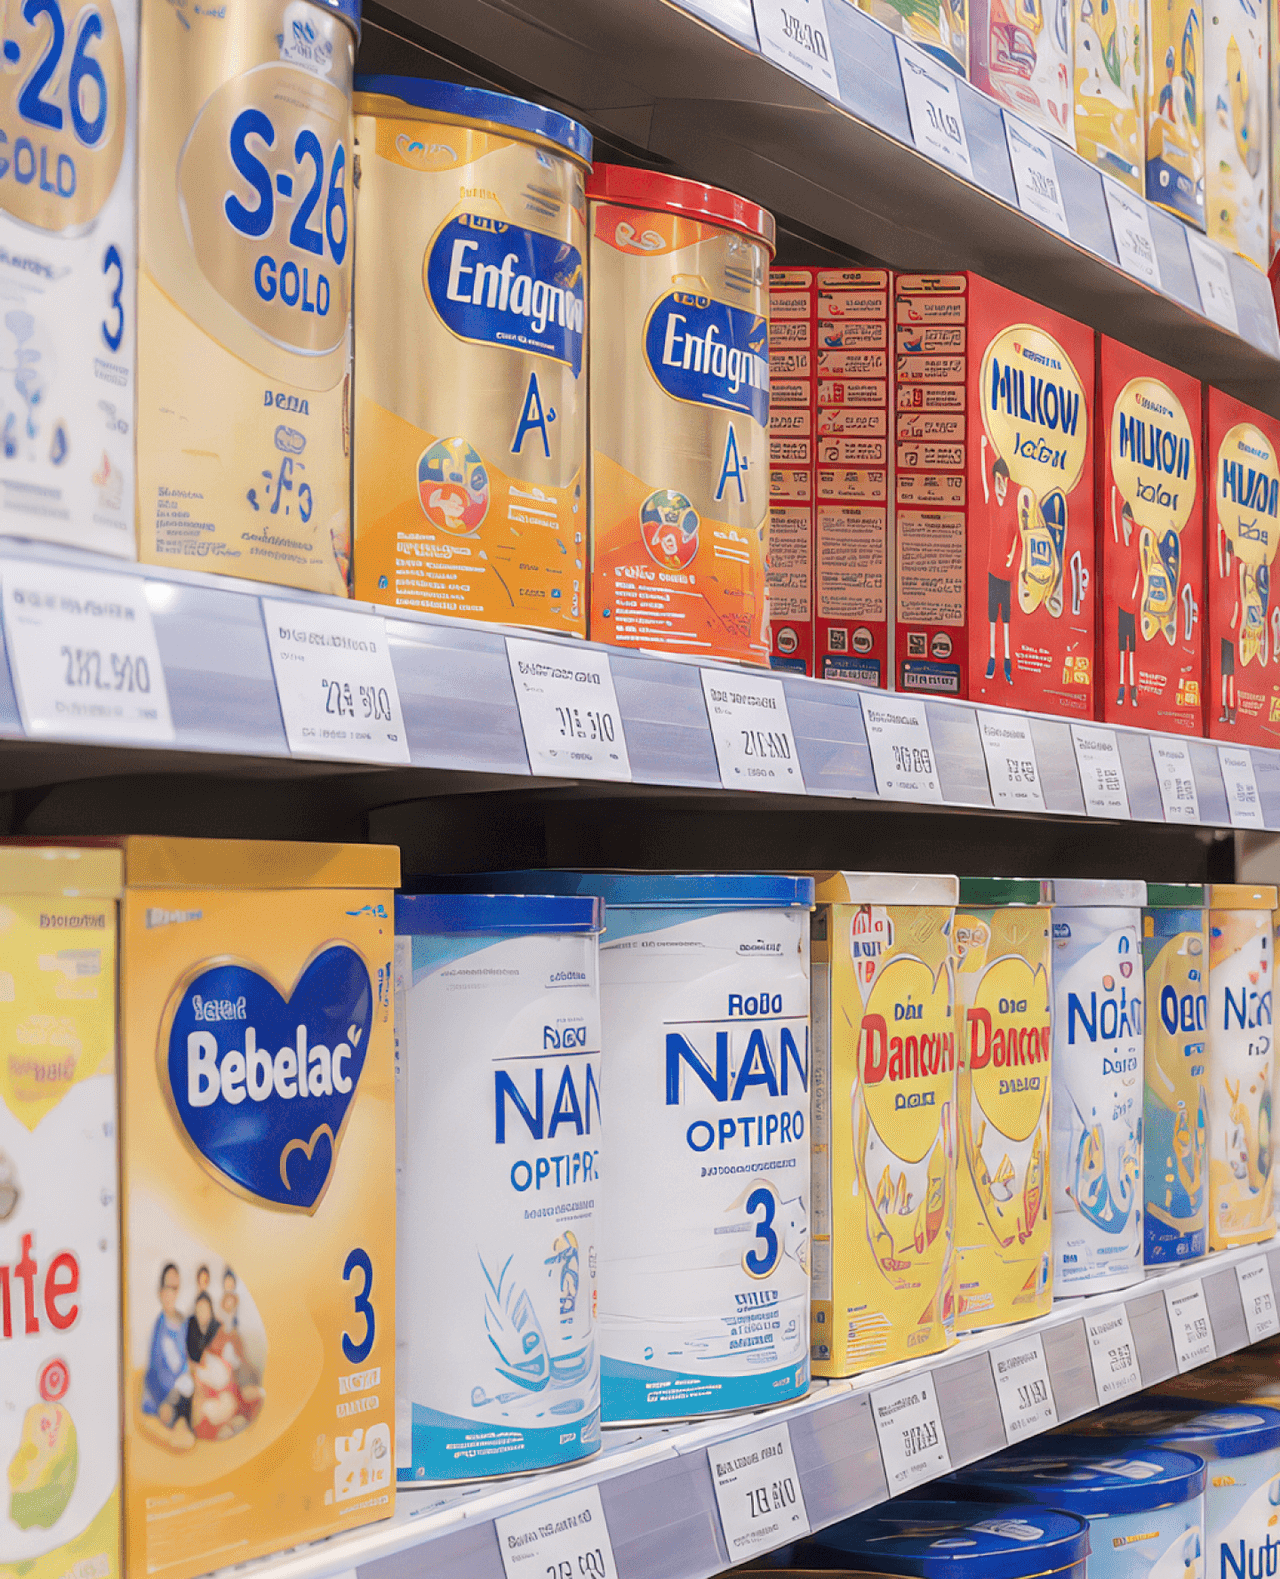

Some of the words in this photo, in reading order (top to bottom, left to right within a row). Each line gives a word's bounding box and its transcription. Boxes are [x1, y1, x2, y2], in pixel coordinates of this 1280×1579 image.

[224, 108, 348, 266] S-26
[101, 244, 125, 352] 3
[254, 255, 330, 316] GOLD
[187, 1025, 352, 1107] Bebelac
[686, 1110, 805, 1152] OPTIPRO
[745, 1187, 779, 1276] 3
[341, 1248, 376, 1364] 3
